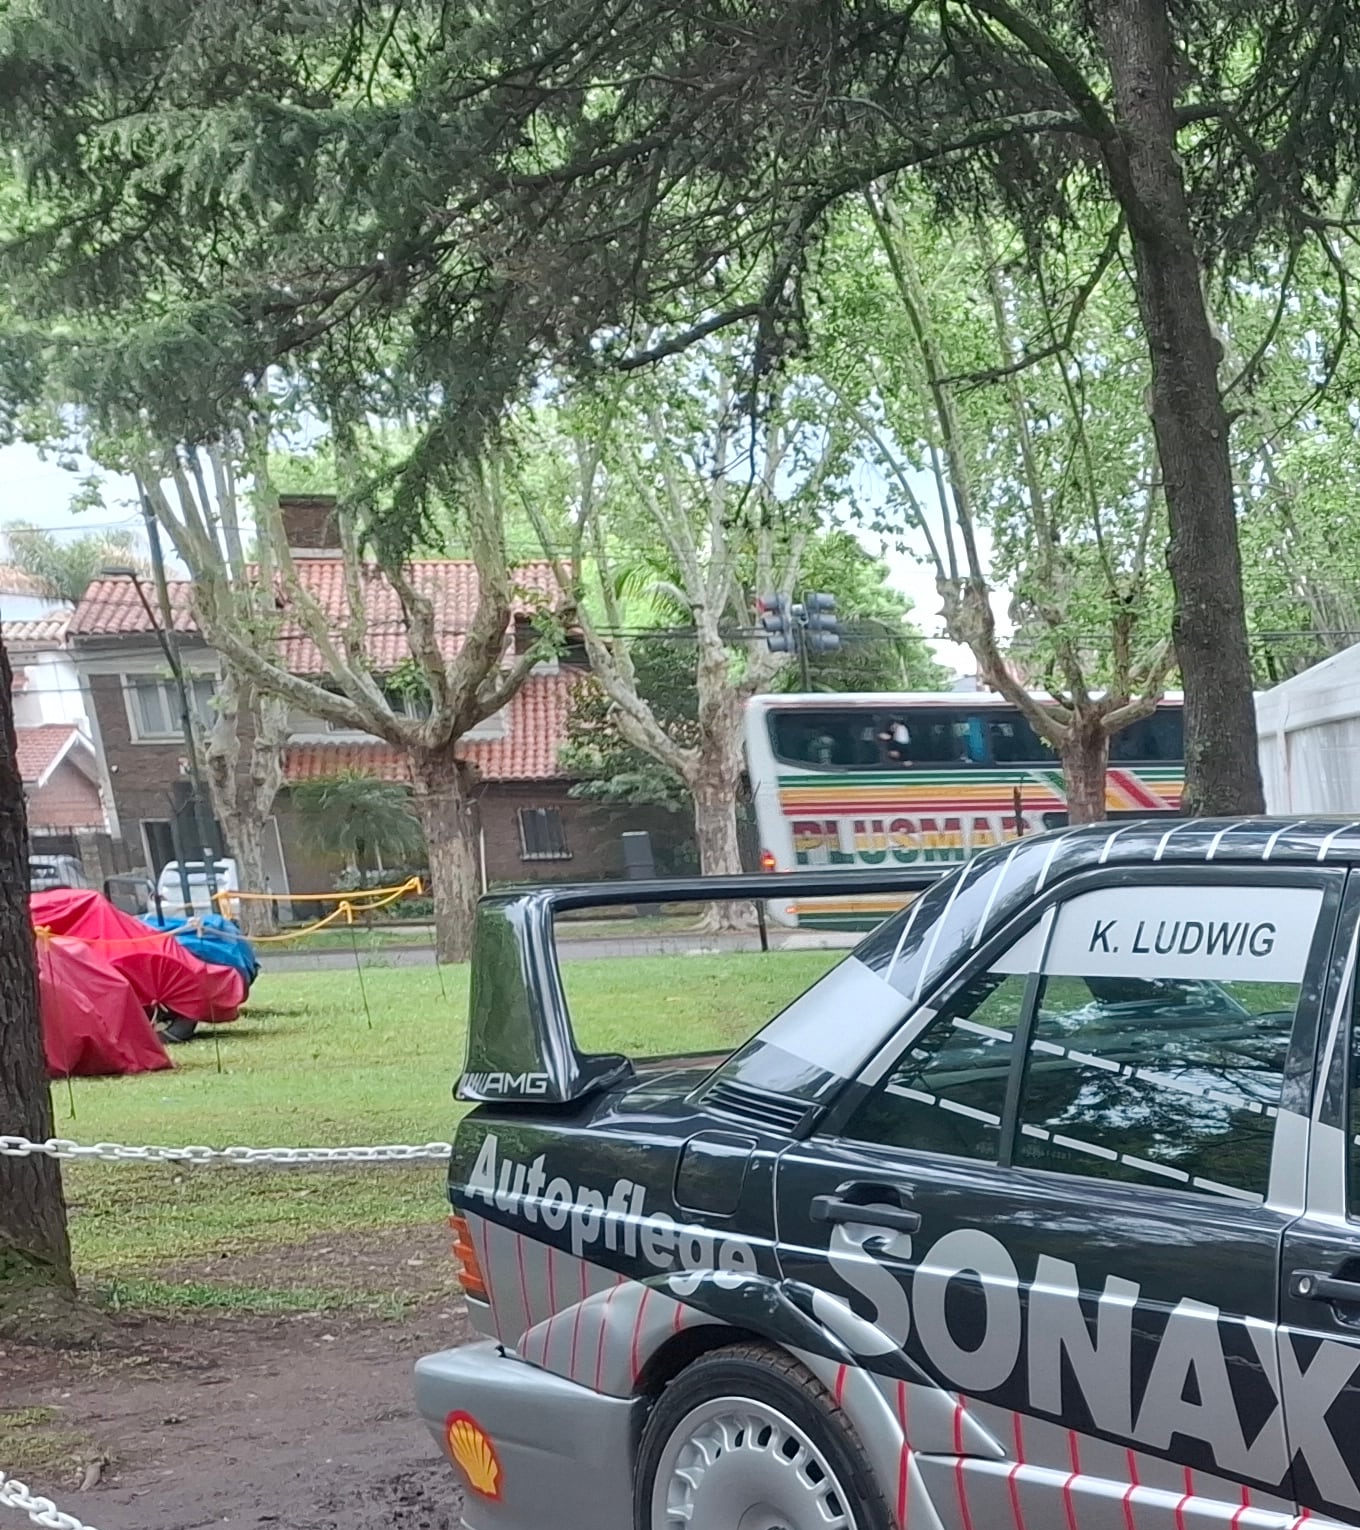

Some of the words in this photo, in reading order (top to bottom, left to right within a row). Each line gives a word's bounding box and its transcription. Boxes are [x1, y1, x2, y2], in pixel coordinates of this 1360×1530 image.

[1089, 920, 1118, 953] K.
[1132, 920, 1276, 957] LUDWIG
[483, 1072, 549, 1094] AMG
[463, 1133, 758, 1297] Autopflege
